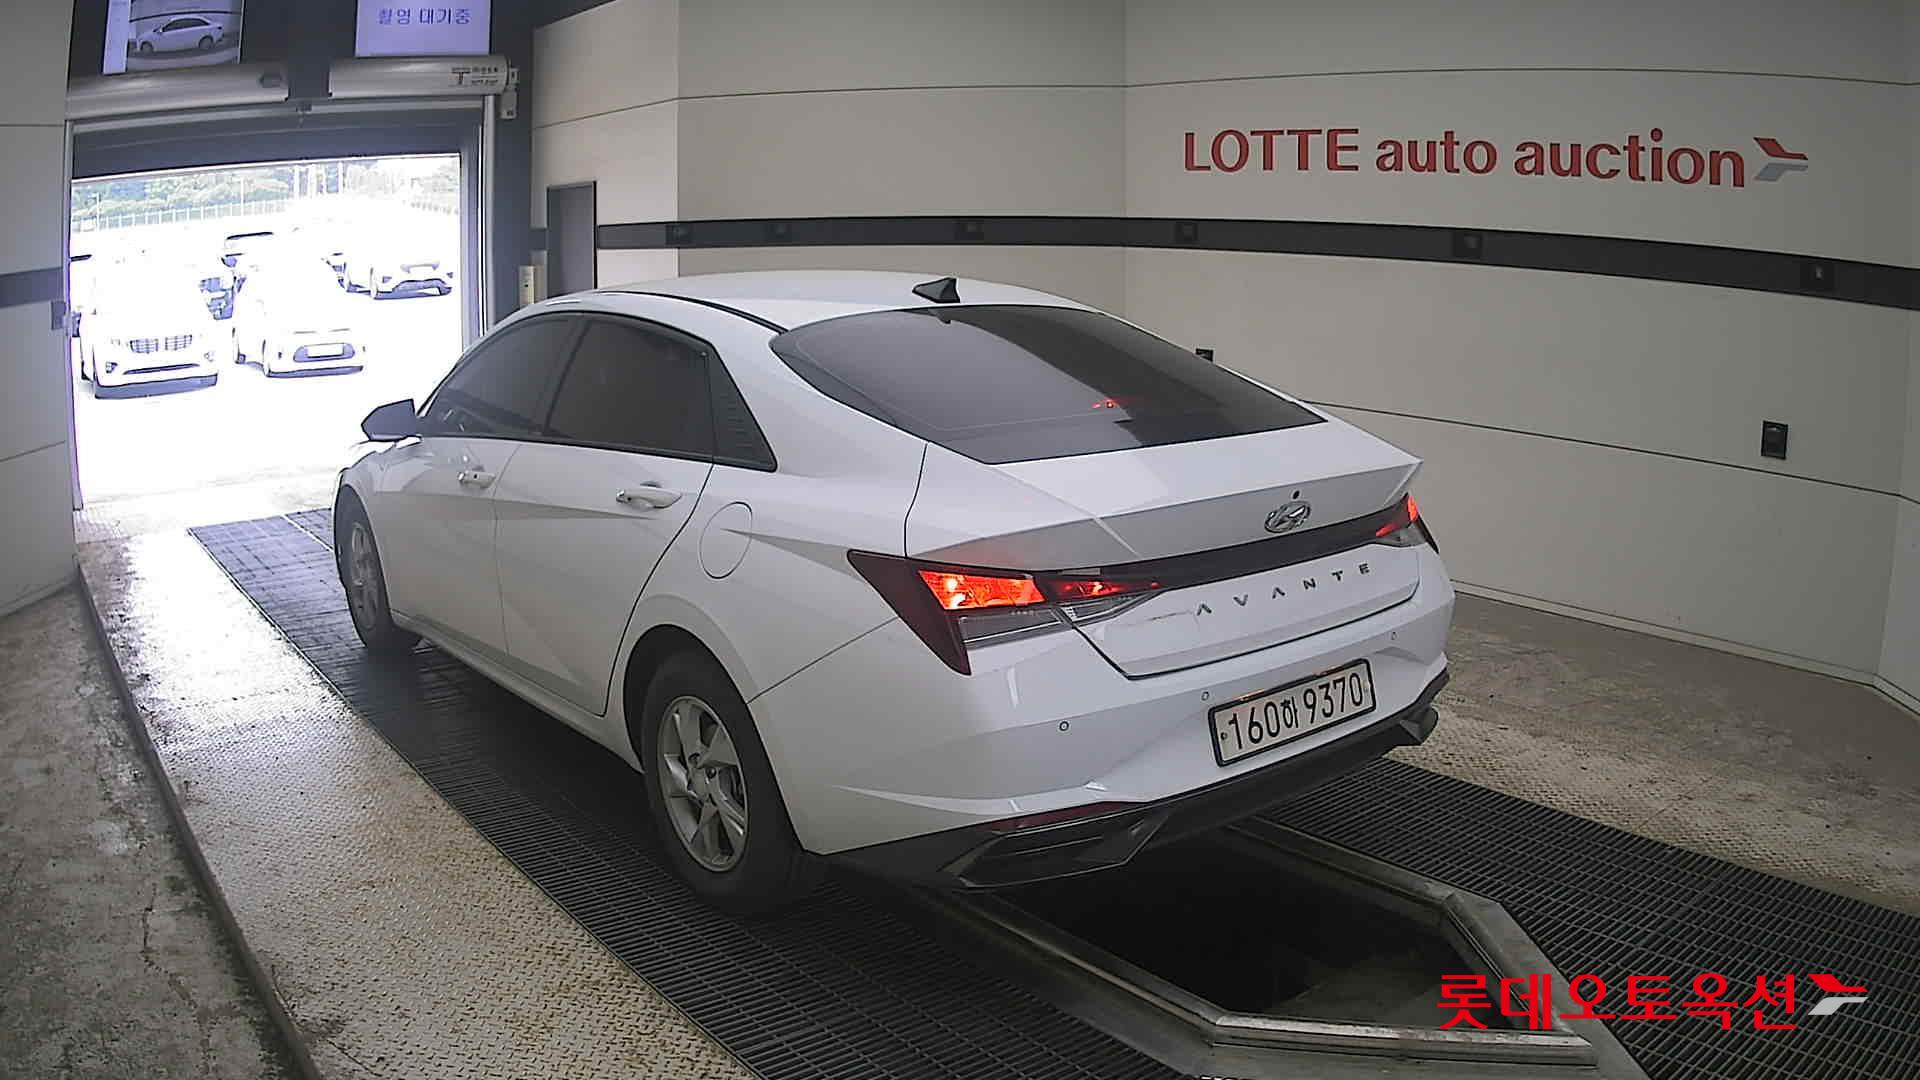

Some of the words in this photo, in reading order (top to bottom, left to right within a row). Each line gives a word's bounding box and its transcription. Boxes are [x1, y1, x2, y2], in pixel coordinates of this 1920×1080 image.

[420, 8, 471, 25] 대기중
[1185, 129, 1359, 172] LOTTE
[1376, 131, 1497, 174] auto
[1515, 128, 1745, 188] auction
[1196, 562, 1371, 616] AVANTE
